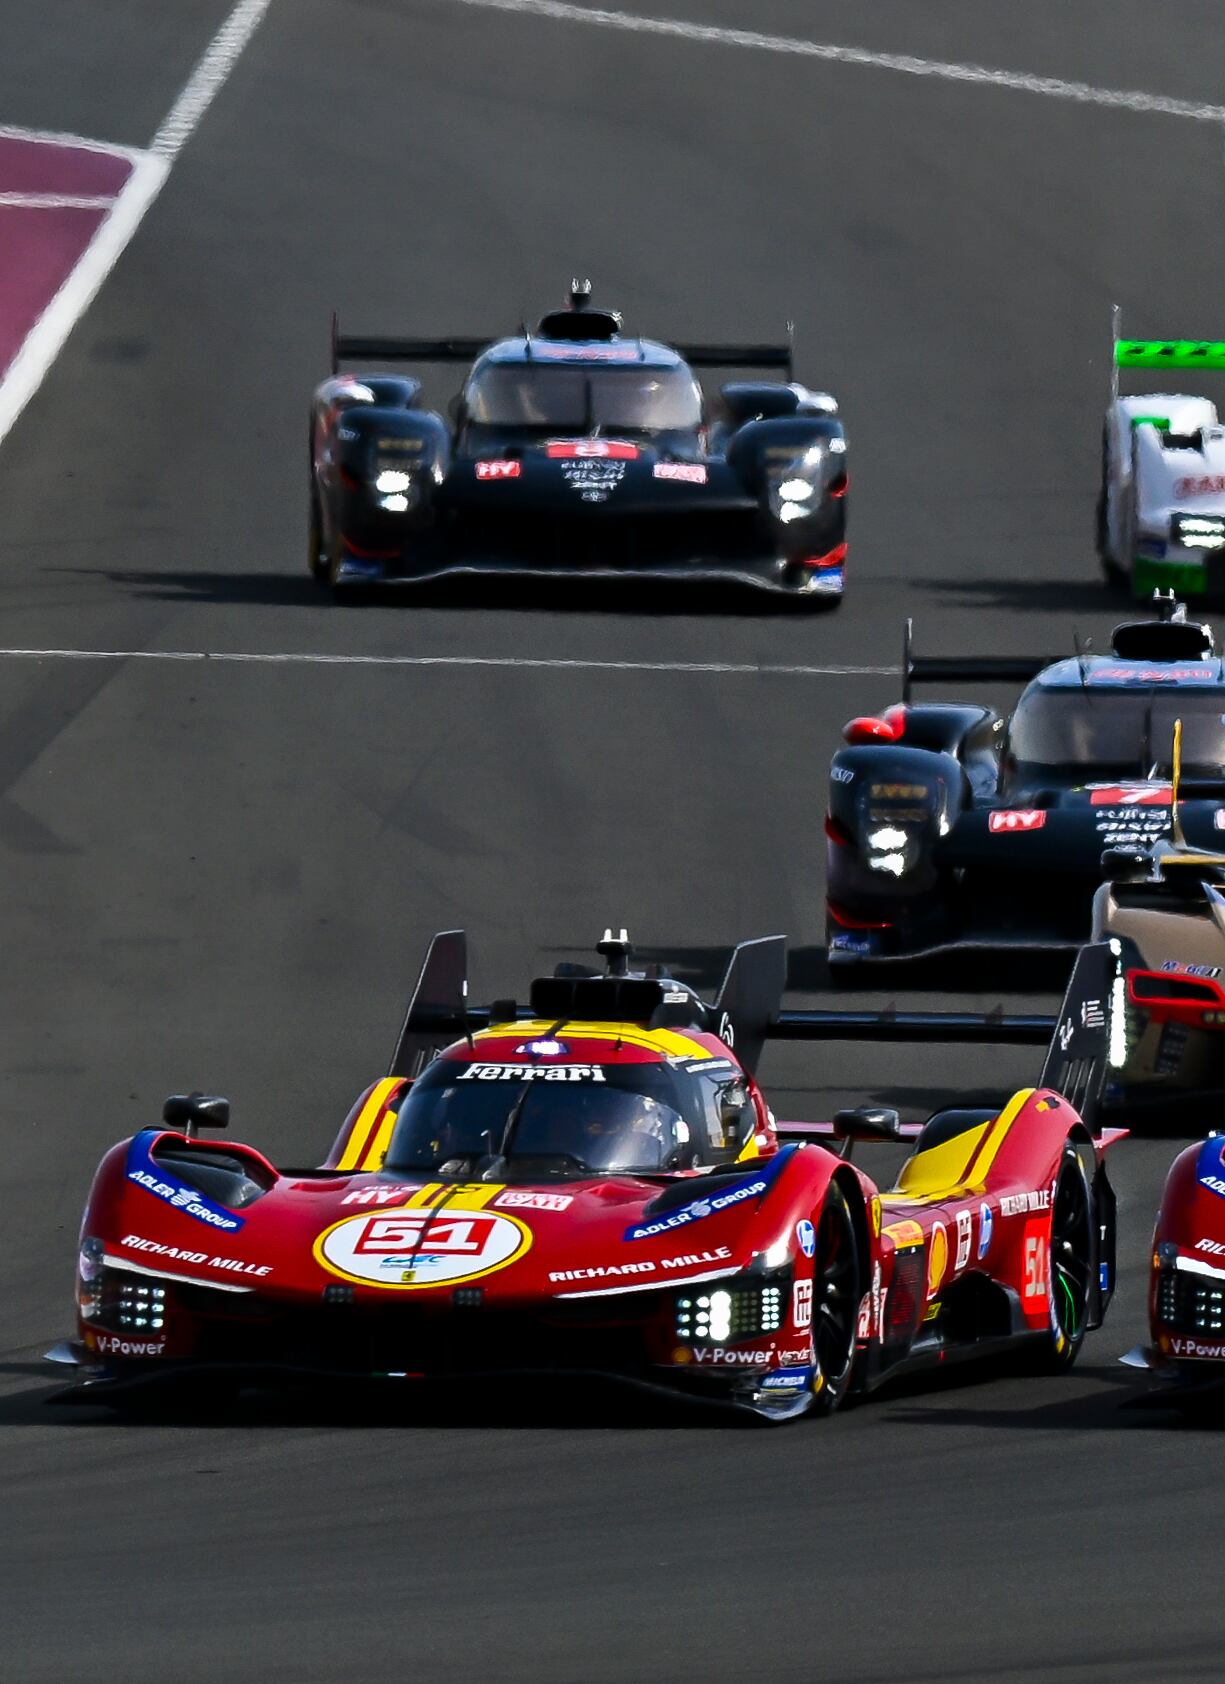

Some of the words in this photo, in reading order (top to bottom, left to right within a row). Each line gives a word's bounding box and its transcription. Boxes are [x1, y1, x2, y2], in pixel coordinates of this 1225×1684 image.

[456, 1062, 606, 1081] Ferrari
[128, 1170, 175, 1198] ADLER
[186, 1203, 237, 1229] GROUP
[341, 1190, 403, 1205] HY
[633, 1212, 692, 1238] ADLER
[711, 1181, 767, 1208] GROUP
[362, 1219, 479, 1250] 51
[121, 1234, 208, 1263] RICHARD
[208, 1257, 274, 1276] MILLE
[548, 1260, 656, 1282] RICHARD
[661, 1246, 733, 1269] MILLE
[97, 1336, 165, 1355] V-Power
[693, 1347, 774, 1364] V-Power
